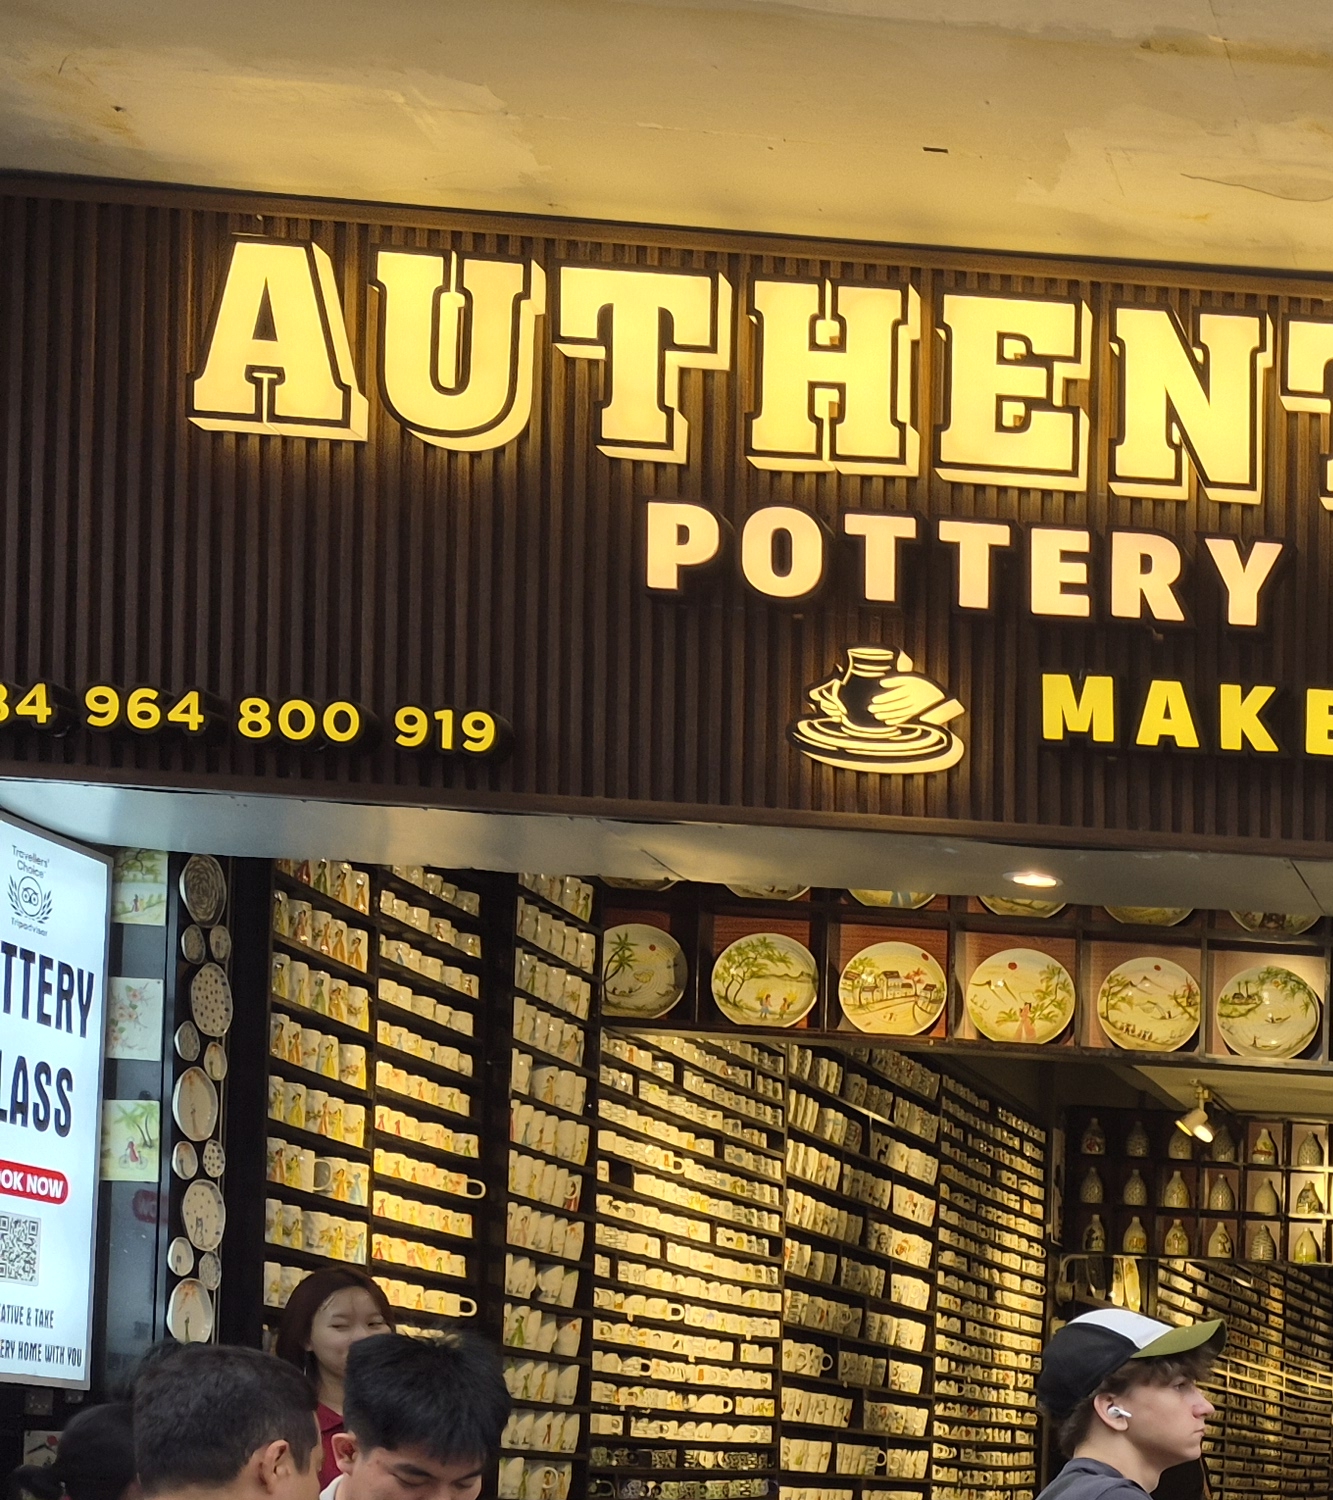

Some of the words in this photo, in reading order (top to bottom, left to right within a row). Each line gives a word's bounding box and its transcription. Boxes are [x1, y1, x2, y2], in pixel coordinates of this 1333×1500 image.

[647, 502, 1283, 626] POTTERY
[84, 686, 204, 731] 964
[237, 697, 360, 742] 800
[394, 706, 496, 753] 919
[17, 860, 46, 878] Choice
[0, 1168, 24, 1191] OK
[26, 1175, 64, 1199] NOW
[0, 1303, 24, 1325] ATIVE
[26, 1307, 31, 1326] &
[35, 1308, 54, 1329] TAKE
[18, 1341, 41, 1362] HOME
[45, 1344, 65, 1365] WITH
[67, 1346, 82, 1367] YOU
